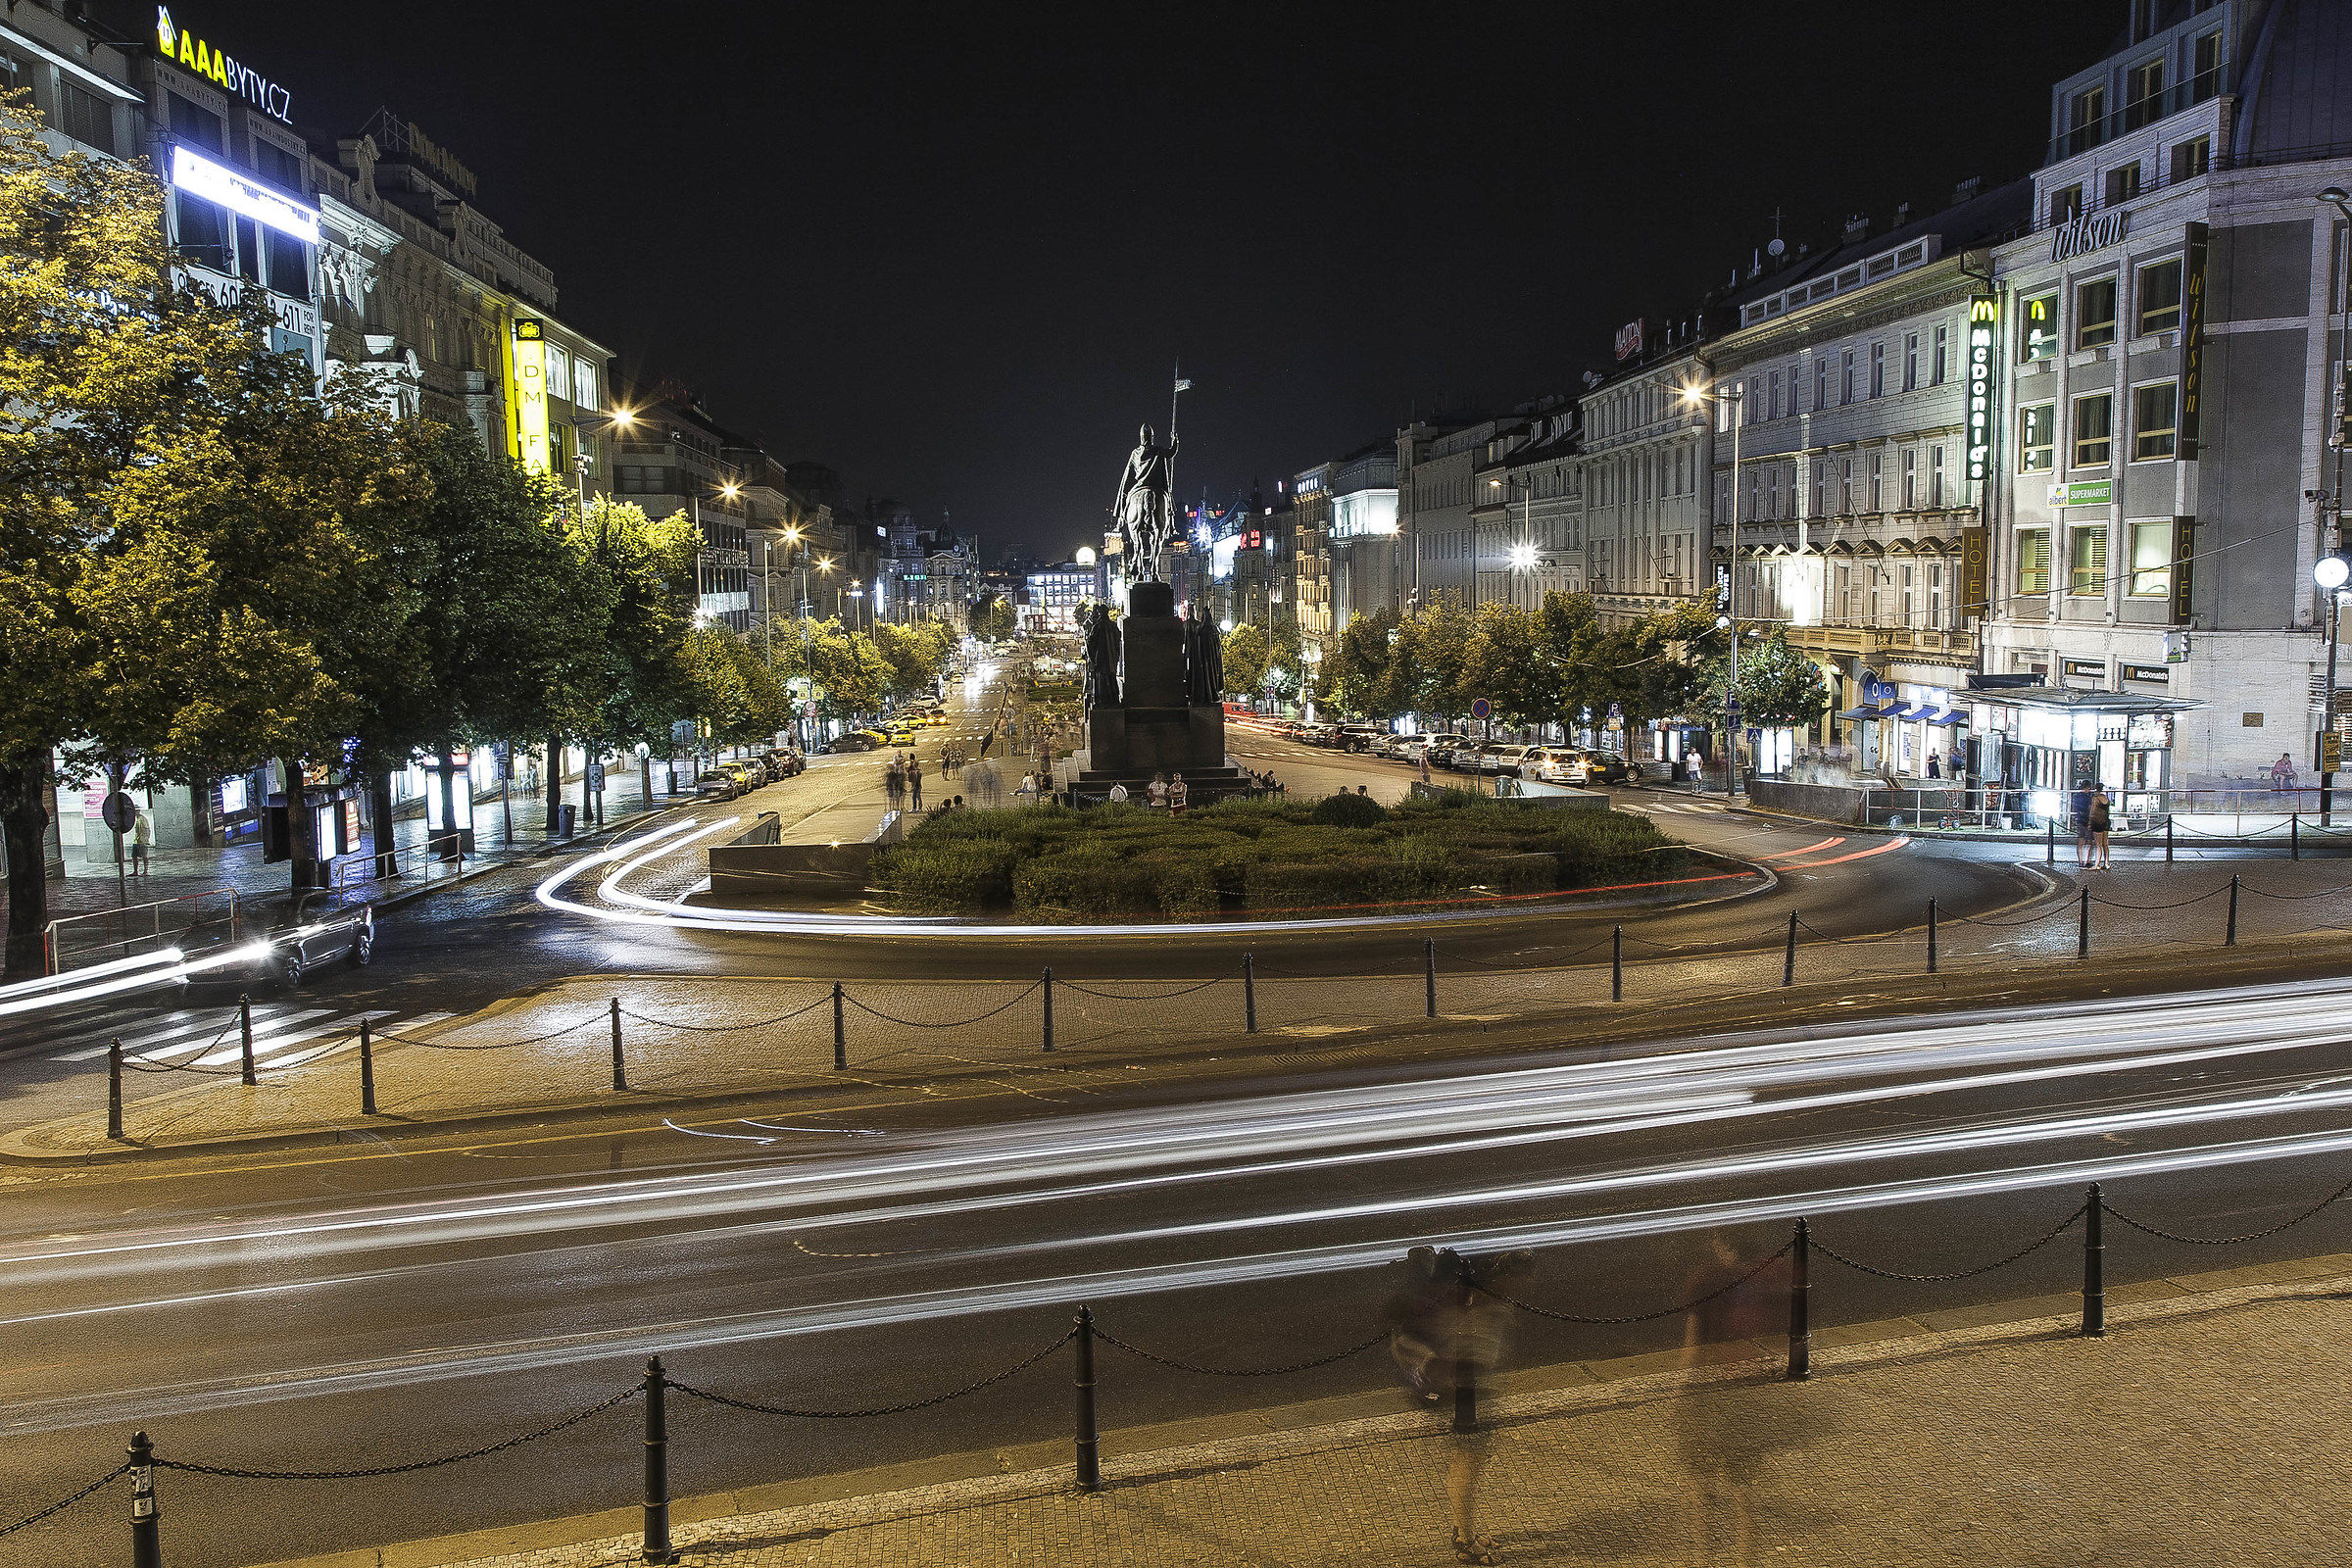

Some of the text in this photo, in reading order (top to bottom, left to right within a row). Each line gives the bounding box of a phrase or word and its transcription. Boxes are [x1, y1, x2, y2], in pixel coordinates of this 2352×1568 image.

[179, 28, 293, 124] AAABYTY.CZ
[303, 310, 315, 322] FOR
[2048, 487, 2110, 506] albert SUPERMARKET
[1968, 534, 1983, 610] HOTEL
[2180, 525, 2191, 616] HOTEL
[2076, 665, 2105, 675] McDonald's
[2136, 669, 2169, 680] McDonald's
